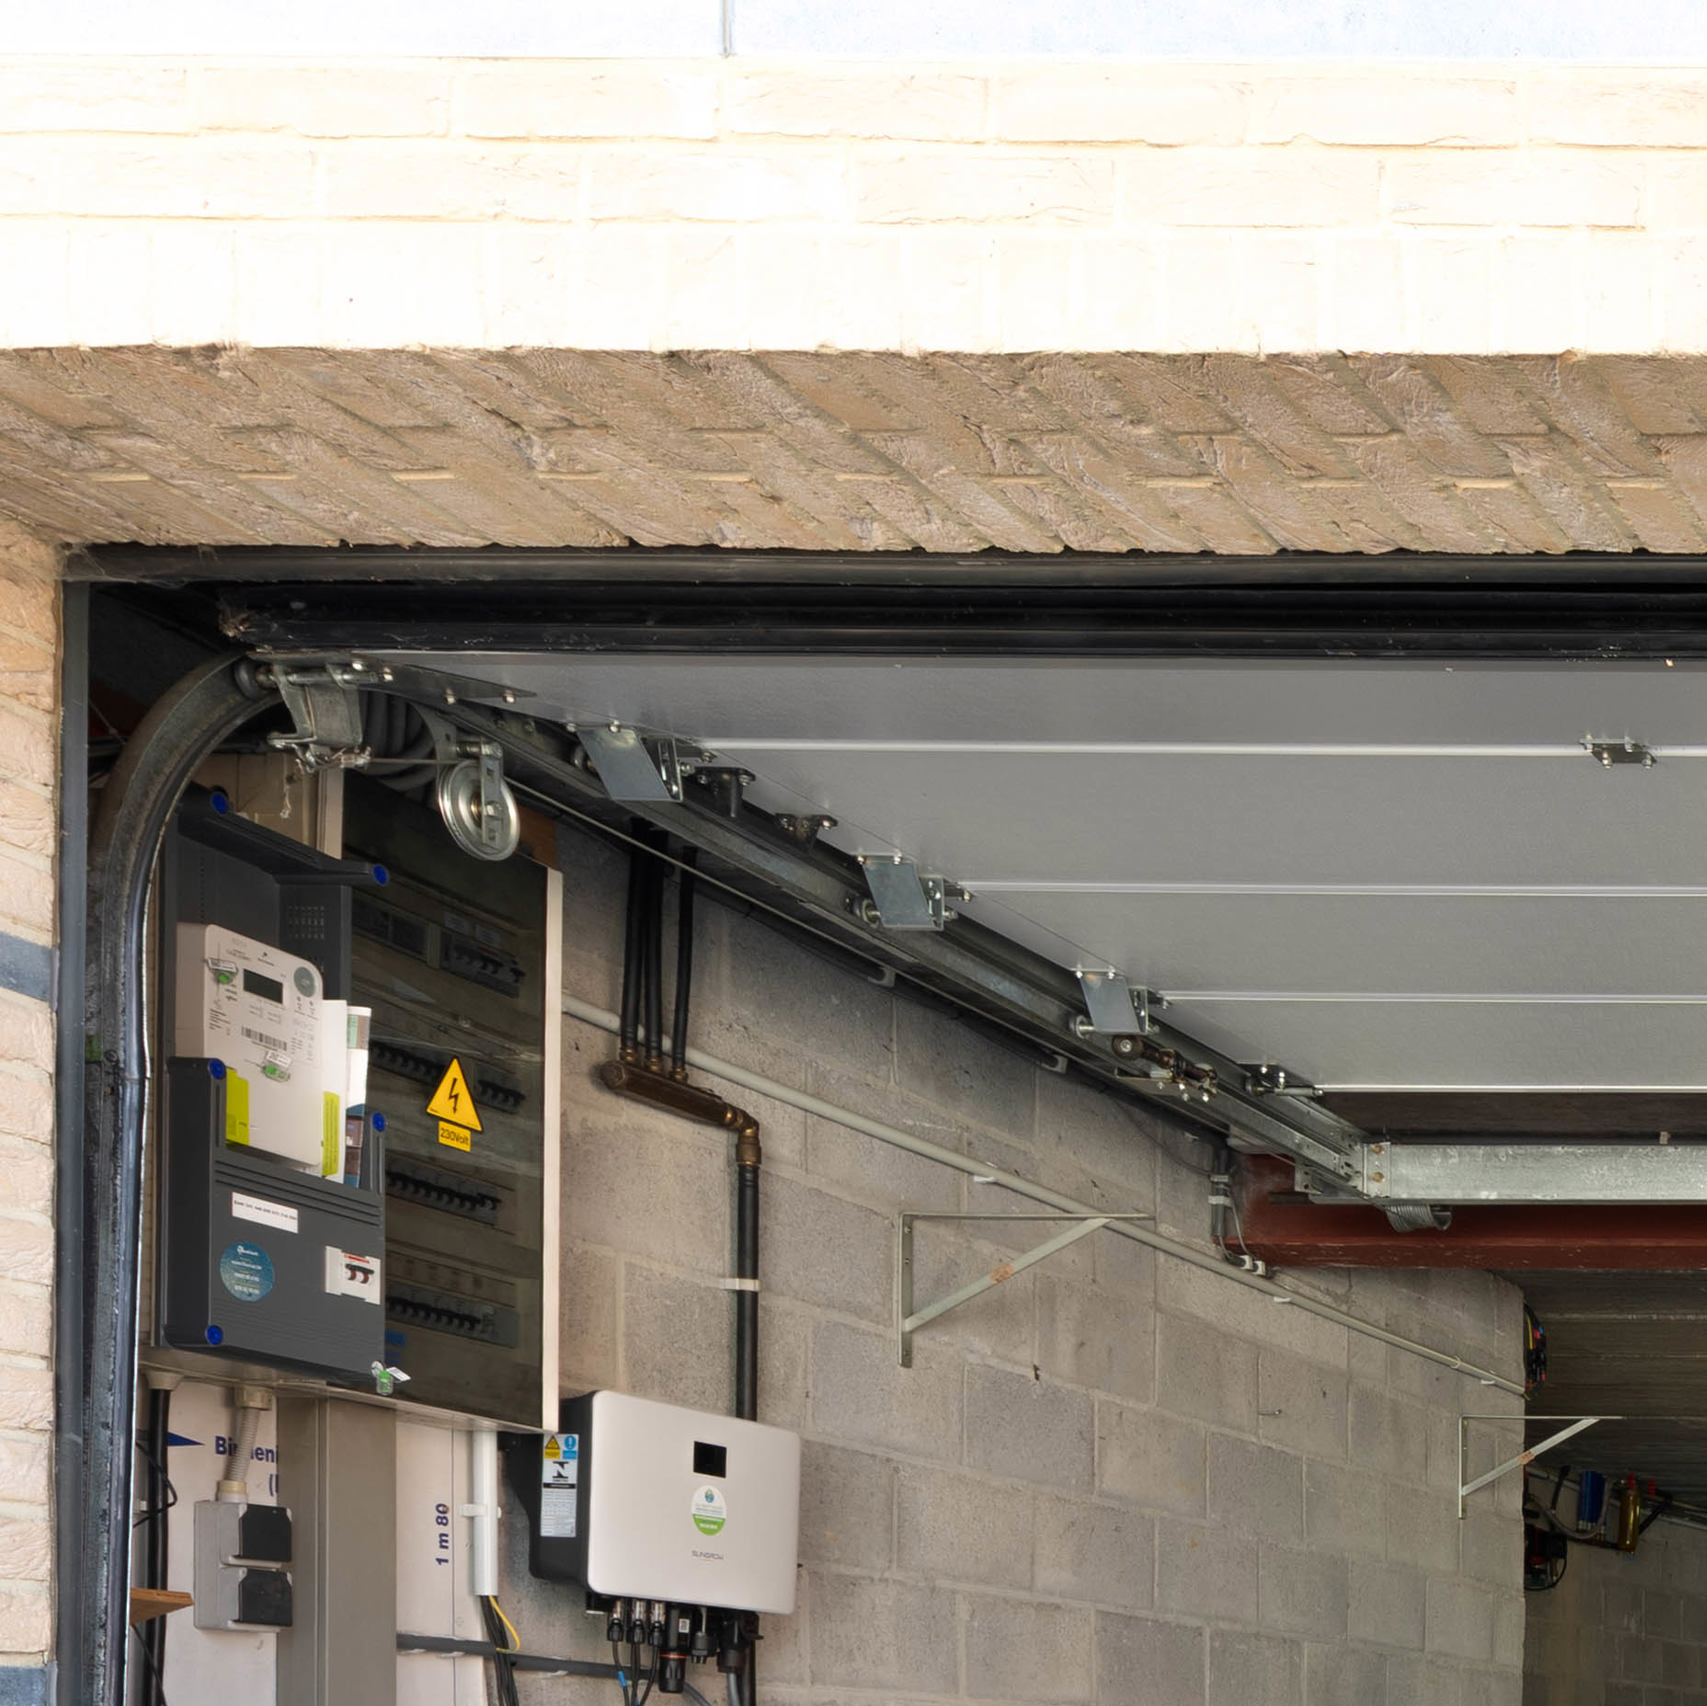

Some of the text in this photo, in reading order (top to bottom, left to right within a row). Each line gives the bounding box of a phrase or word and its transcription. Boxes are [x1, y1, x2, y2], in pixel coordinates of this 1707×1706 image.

[435, 1503, 449, 1566] 1 m 80
